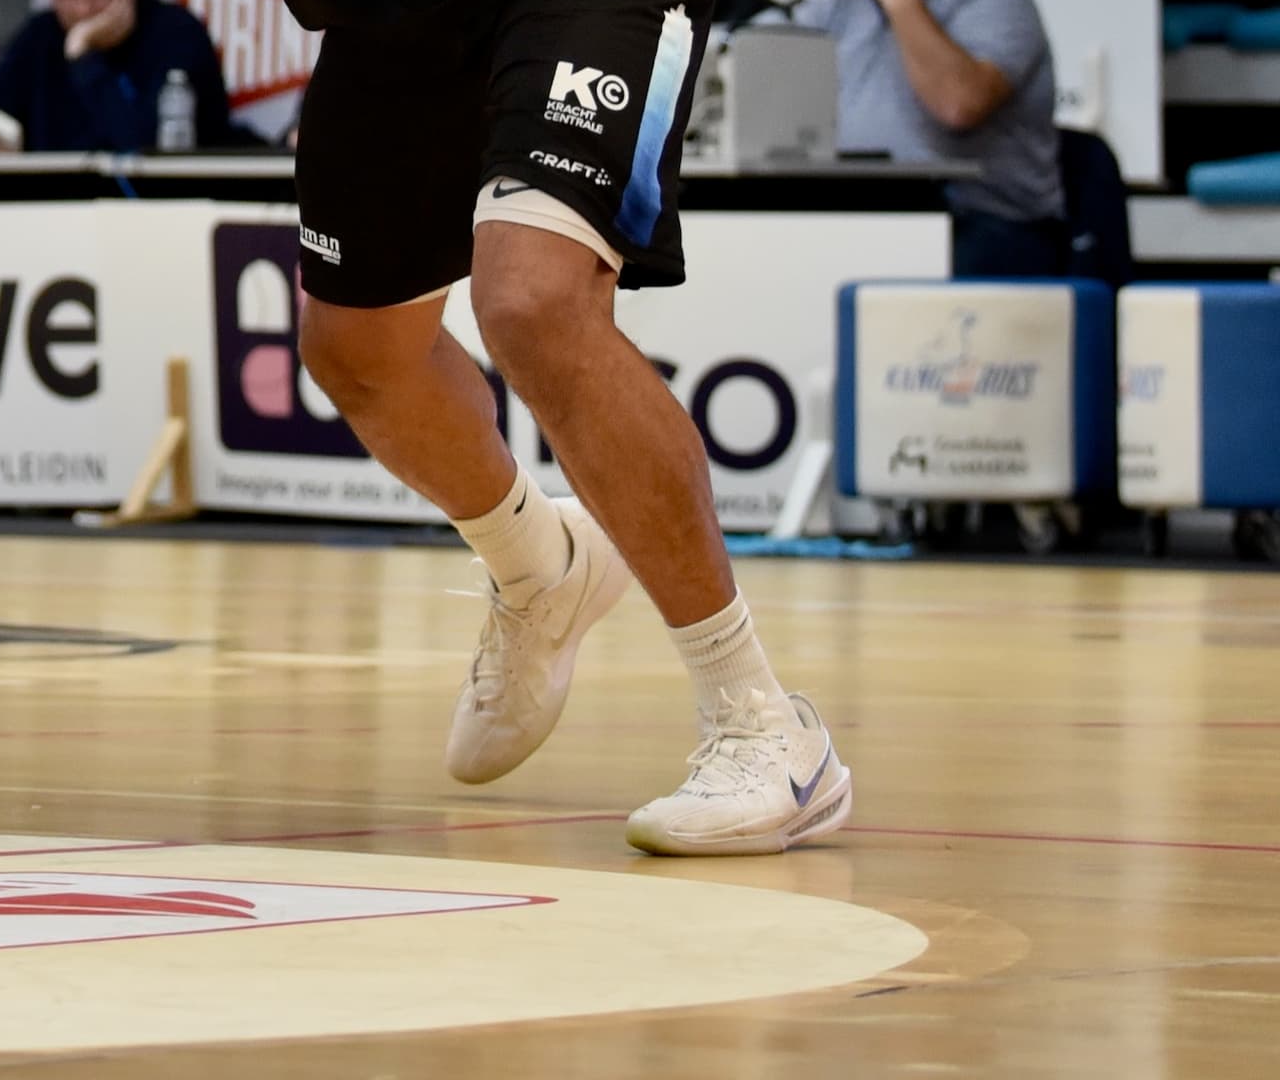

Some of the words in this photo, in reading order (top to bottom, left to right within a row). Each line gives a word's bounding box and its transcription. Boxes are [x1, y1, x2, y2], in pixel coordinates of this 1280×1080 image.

[544, 110, 604, 135] CENTRALE
[546, 100, 597, 121] KRACHT
[529, 150, 597, 179] CRAFT
